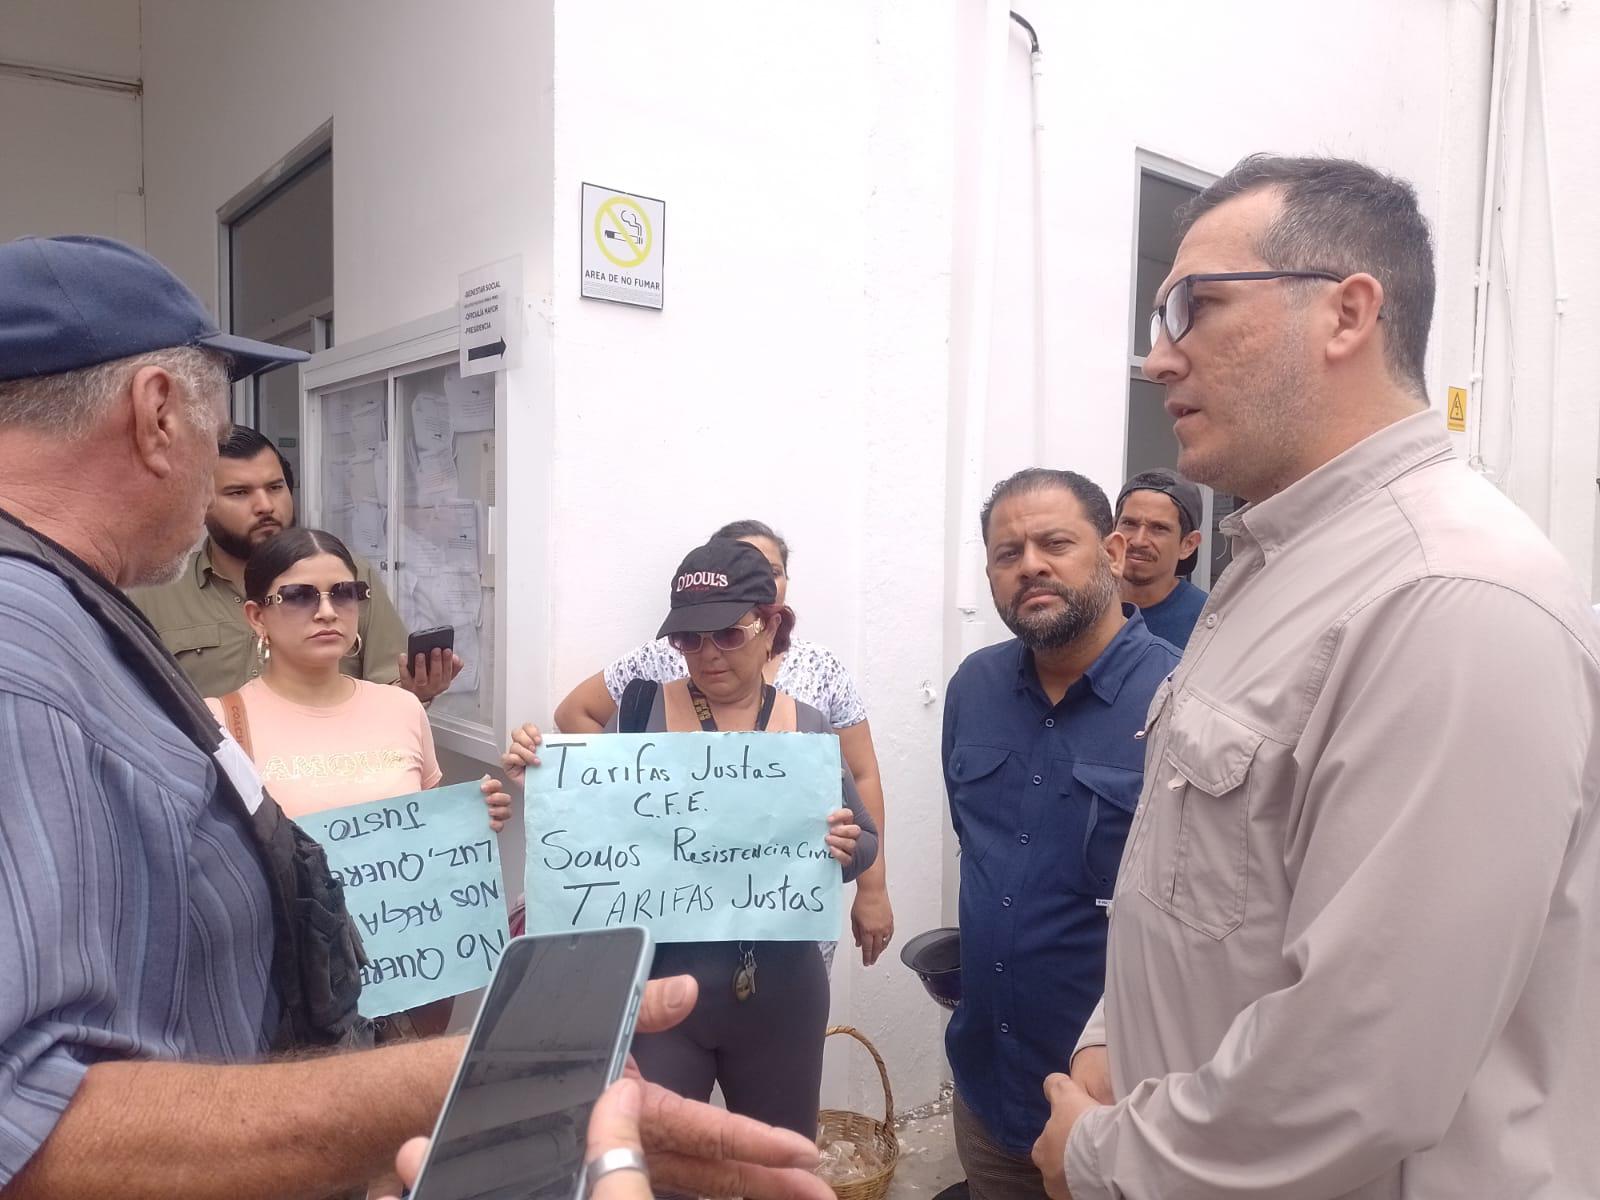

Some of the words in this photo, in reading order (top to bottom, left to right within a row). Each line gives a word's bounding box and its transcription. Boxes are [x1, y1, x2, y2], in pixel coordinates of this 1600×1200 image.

[585, 269, 606, 281] AREA
[608, 273, 618, 283] DE
[621, 275, 632, 286] NO
[634, 278, 660, 290] FUMAR
[545, 742, 671, 788] Tarifas
[691, 745, 786, 781] Justas
[323, 801, 426, 841] JUSTO.
[634, 790, 708, 818] C.F.E.
[331, 849, 425, 887] QUERE
[427, 839, 493, 868] LUZ,
[449, 878, 500, 908] NOS
[563, 881, 713, 927] TARIFAS
[731, 873, 824, 912] Justas
[352, 898, 443, 943] REGA
[359, 947, 445, 986] QUERE
[456, 929, 505, 972] NO
